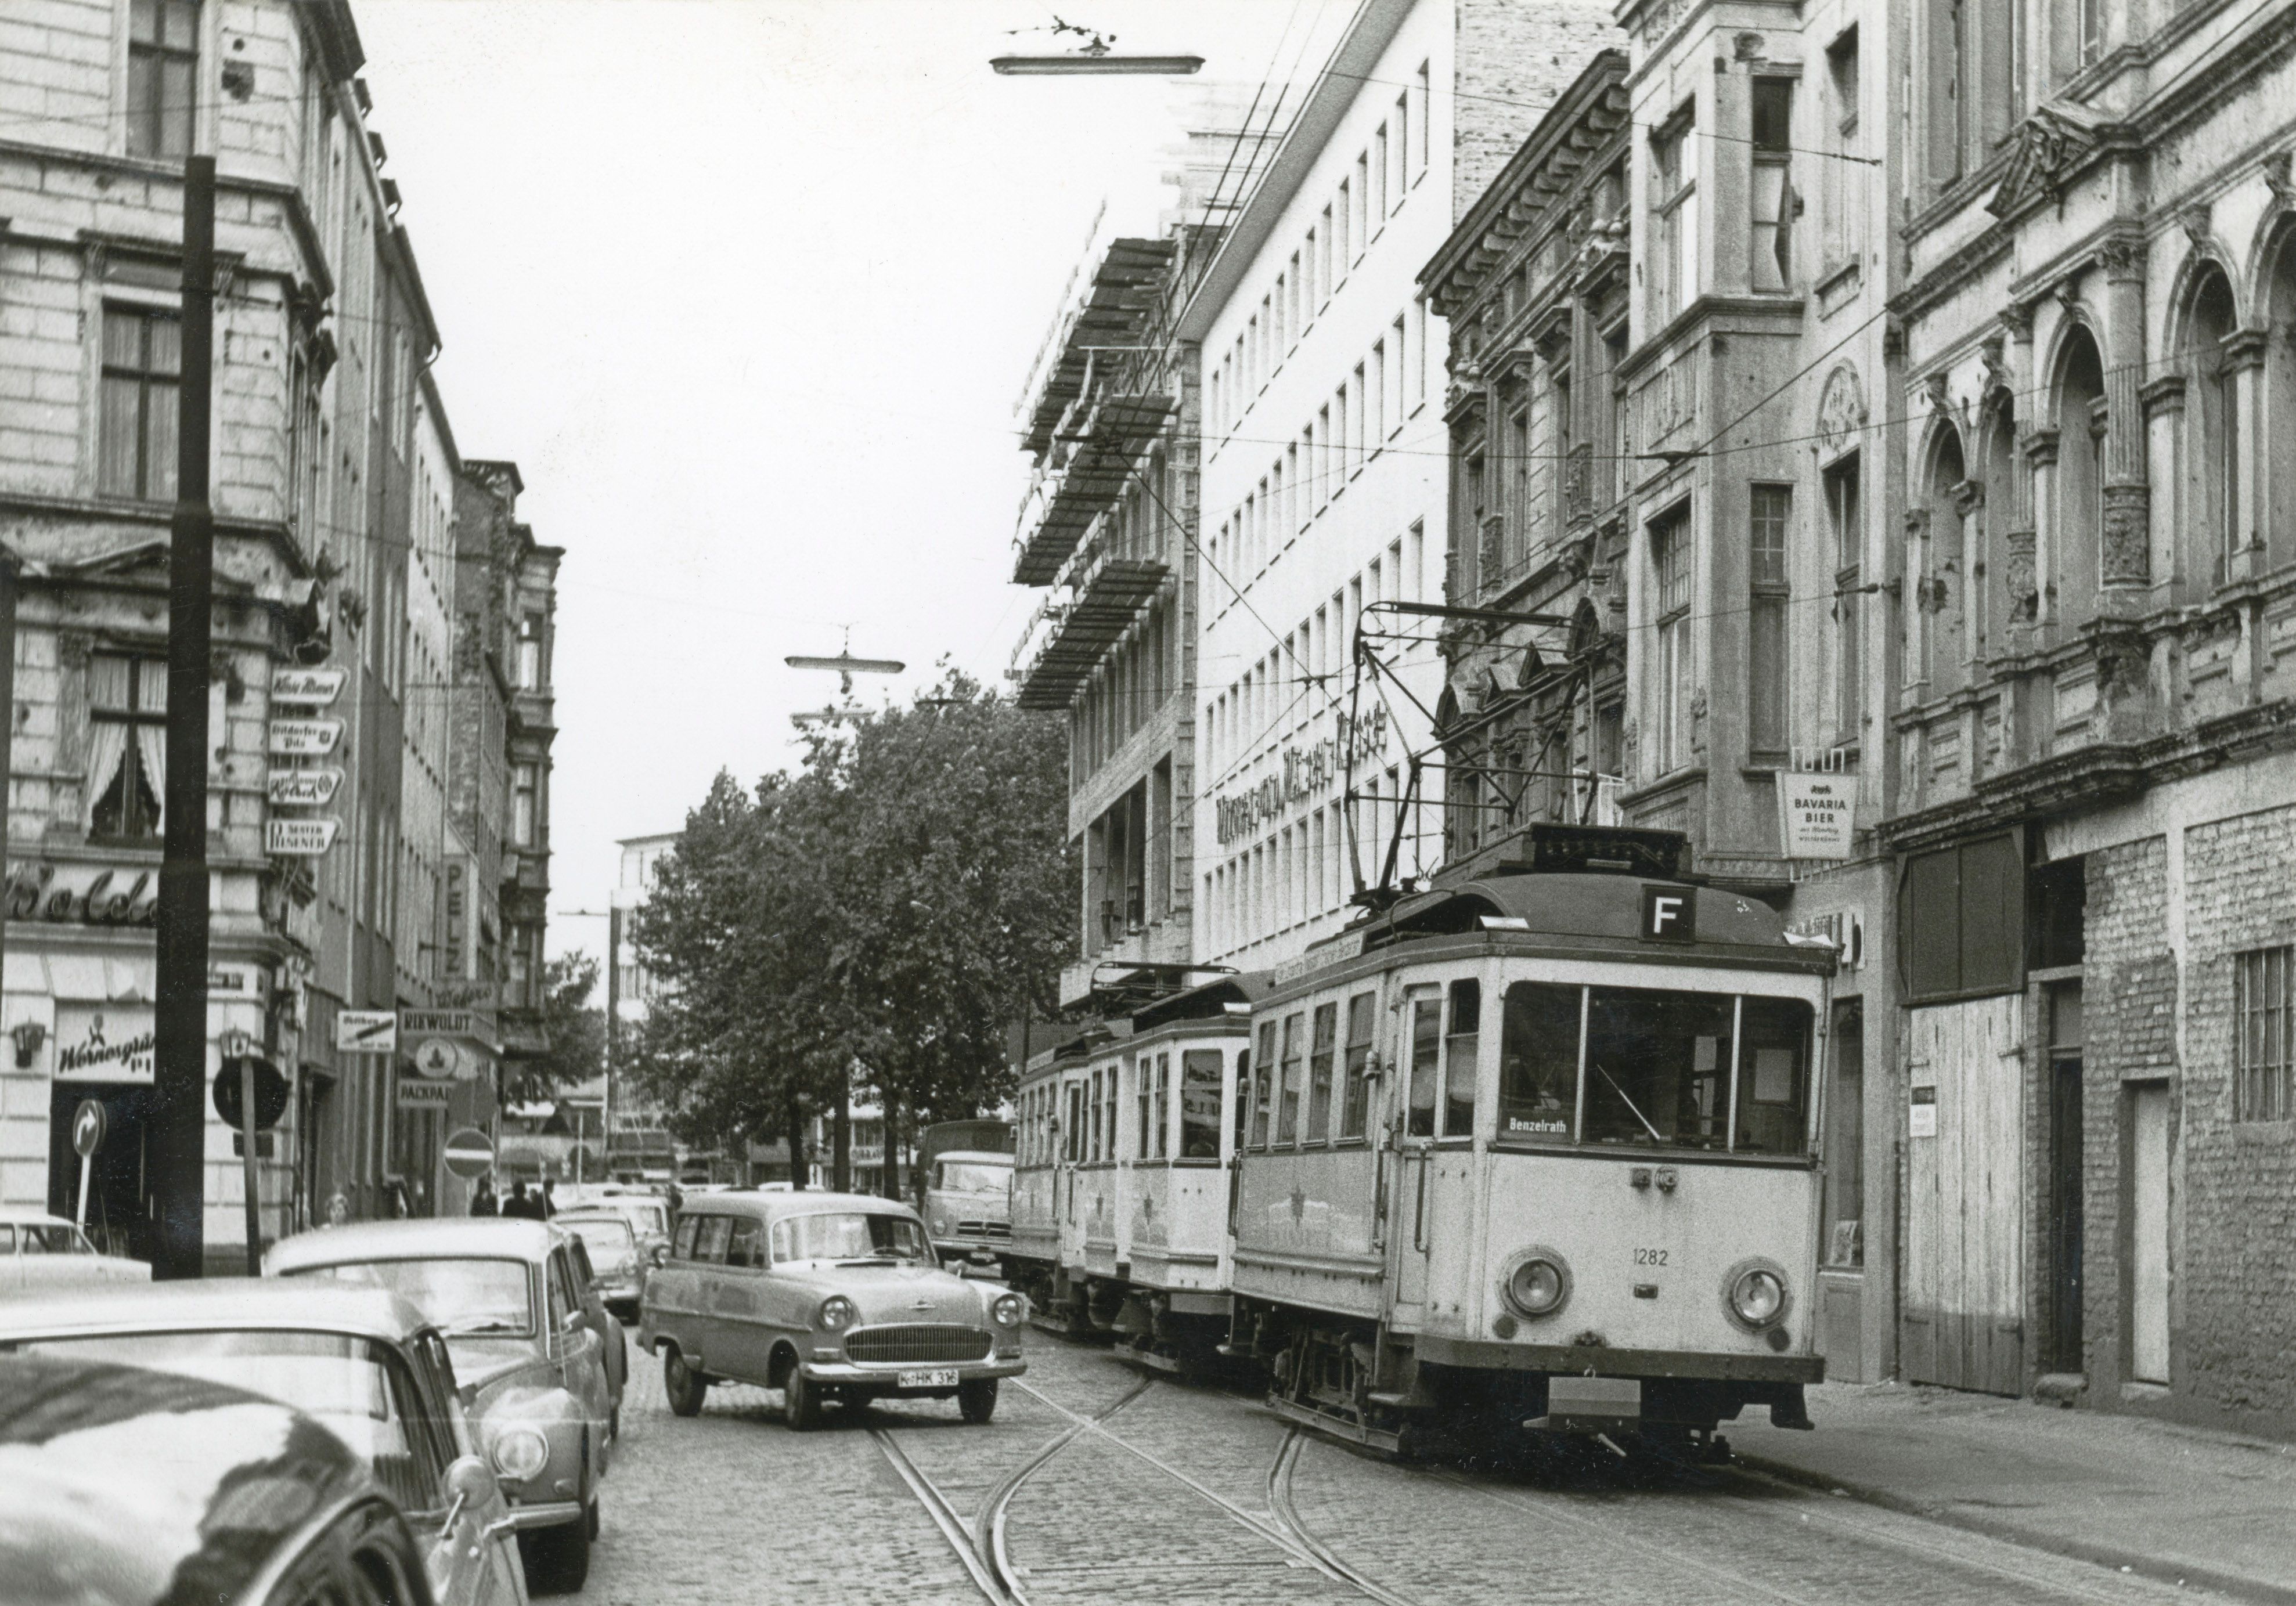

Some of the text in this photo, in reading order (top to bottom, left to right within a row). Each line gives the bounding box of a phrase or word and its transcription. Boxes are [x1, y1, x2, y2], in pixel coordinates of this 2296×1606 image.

[1794, 799, 1846, 810] BAVARIA
[1805, 813, 1834, 822] BIER
[445, 864, 462, 973] PELZ
[1653, 897, 1683, 934] F
[404, 1014, 471, 1031] RIEWOLDT
[1509, 1117, 1566, 1134] Benzelrath
[1633, 1248, 1668, 1266] 1282
